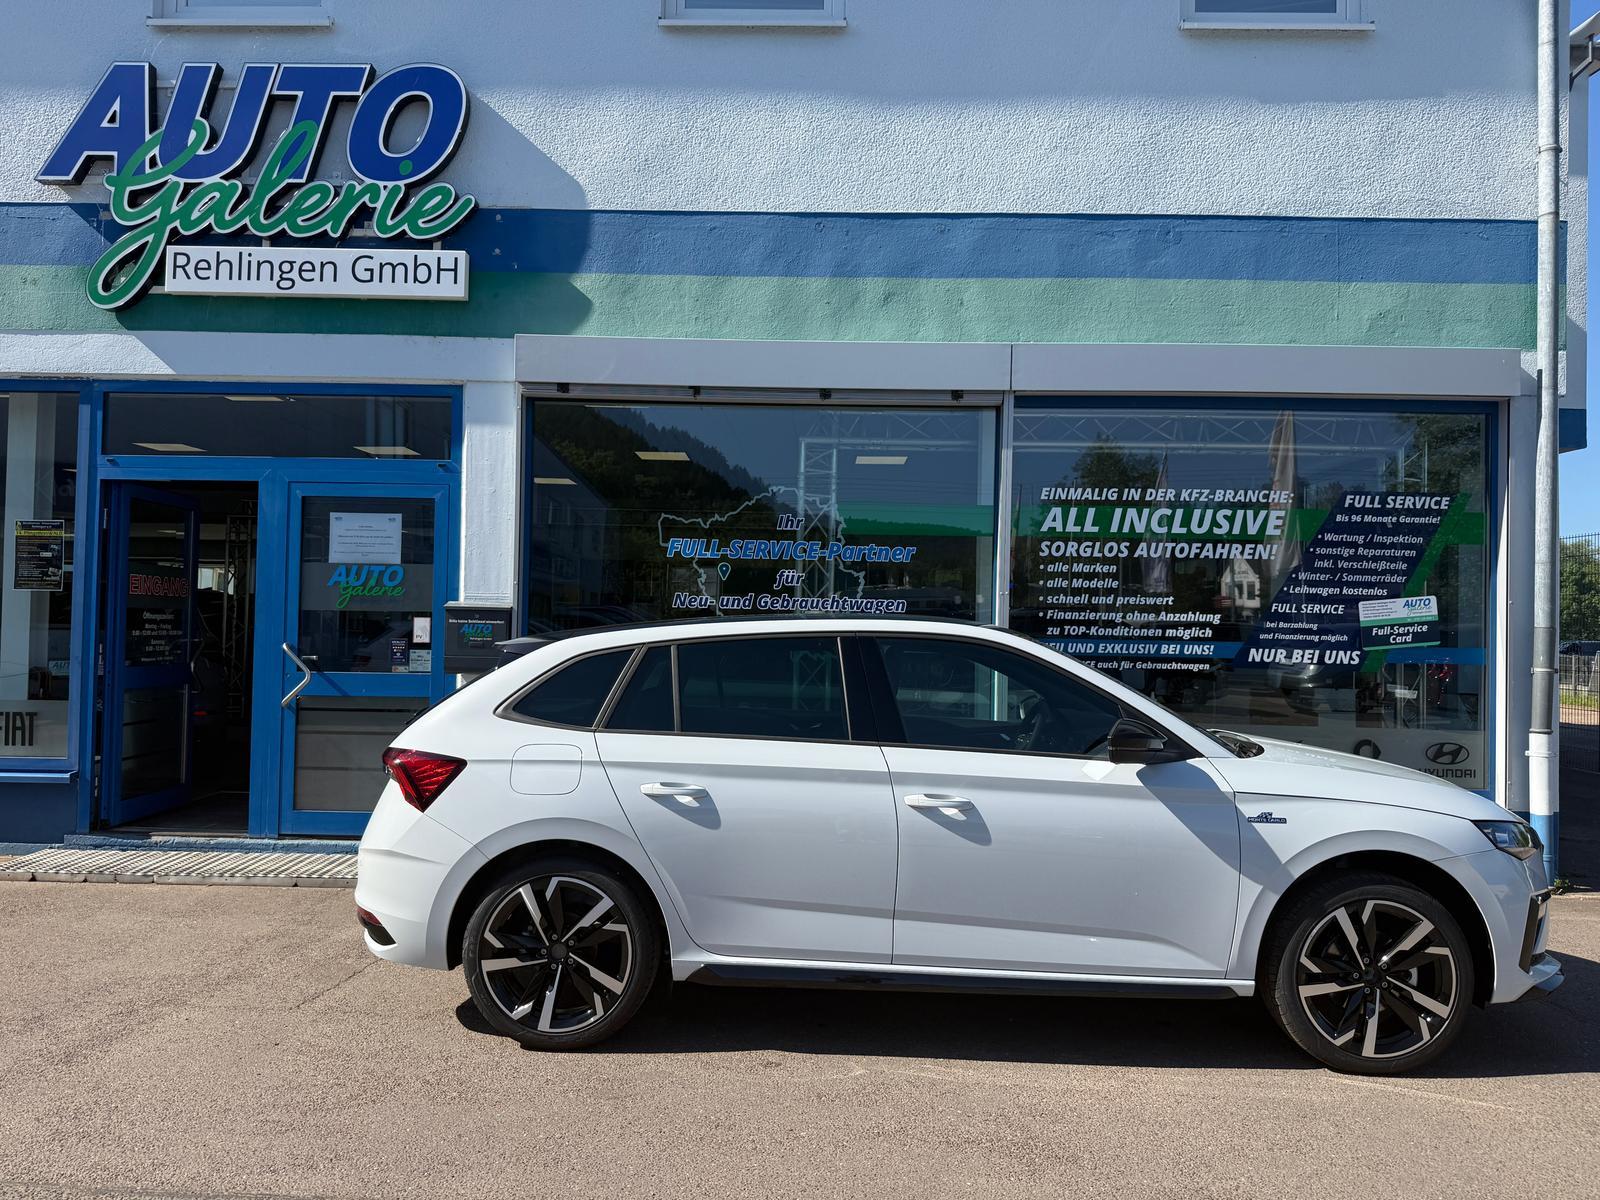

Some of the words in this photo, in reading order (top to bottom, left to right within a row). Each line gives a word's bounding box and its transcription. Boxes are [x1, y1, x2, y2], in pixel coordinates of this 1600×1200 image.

[35, 61, 470, 185] AUTO
[85, 117, 478, 311] Galerie
[172, 251, 338, 290] Rehlingen
[351, 254, 460, 285] GmbH
[1040, 487, 1118, 500] EINMALIG
[1122, 488, 1141, 500] IN
[1145, 488, 1176, 501] DER
[1180, 489, 1294, 503] KFZ-BRANCHE:
[1344, 495, 1382, 508] FULL
[1386, 496, 1451, 510] SERVICE
[777, 514, 805, 530] Ihr
[1040, 507, 1100, 532] ALL
[1110, 508, 1284, 536] INCLUSIVE
[1336, 514, 1349, 522] Bis
[1351, 514, 1362, 522] 96
[1363, 514, 1397, 523] Monate
[1399, 515, 1440, 524] Garantie!
[1324, 533, 1365, 544] Wartung
[1366, 533, 1372, 542] /
[1373, 534, 1423, 545] Inspektion
[666, 537, 916, 563] FULL-SERVICE-Partner
[1039, 541, 1129, 558] SORGLOS
[1134, 542, 1279, 560] AUTOFAHREN!
[1315, 547, 1355, 558] sonstige
[1357, 548, 1417, 558] Reparaturen
[1046, 562, 1069, 573] alle
[1071, 563, 1117, 574] Marken
[1314, 560, 1335, 568] inkl.
[1337, 560, 1408, 571] Verschleißteile
[328, 565, 405, 587] AUTO
[773, 570, 805, 590] für
[1298, 572, 1333, 582] Winter-
[1334, 573, 1340, 581] /
[1342, 573, 1407, 583] Sommerräder
[129, 574, 190, 597] EINGANG
[1046, 577, 1069, 589] alle
[1071, 578, 1119, 589] Modelle
[1289, 585, 1340, 596] Leihwagen
[1342, 586, 1388, 597] kostenlos
[672, 592, 716, 609] Neu-
[720, 593, 752, 610] und
[757, 594, 907, 614] Gebrauchtwagen
[1046, 594, 1089, 605] schnell
[1091, 594, 1113, 605] und
[1116, 595, 1175, 607] preiswert
[1403, 598, 1431, 609] AUTO
[1271, 603, 1298, 613] FULL
[1300, 604, 1345, 614] SERVICE
[1046, 609, 1123, 623] Finanzierung
[1125, 610, 1155, 621] ohne
[1158, 611, 1222, 624] Anzahlung
[459, 624, 493, 633] AUTO
[1046, 626, 1061, 635] zu
[1063, 625, 1163, 637] TOP-Konditionen
[1165, 626, 1213, 640] möglich
[1279, 622, 1318, 630] Barzahlung
[1372, 624, 1428, 637] Full-Service
[1274, 633, 1319, 642] Finanzierung
[1321, 634, 1348, 642] möglich
[1390, 634, 1412, 644] Card
[1067, 643, 1095, 654] UND
[1098, 643, 1158, 655] EXKLUSIV
[1160, 644, 1181, 655] BEI
[1183, 644, 1215, 655] UNS!
[1248, 648, 1289, 663] NUR
[1292, 650, 1318, 664] BEI
[1324, 651, 1361, 665] UNS
[1097, 661, 1118, 670] auch
[1120, 660, 1134, 671] für
[1135, 661, 1210, 672] Gebrauchtwagen
[1417, 768, 1476, 779] YUNDAI
